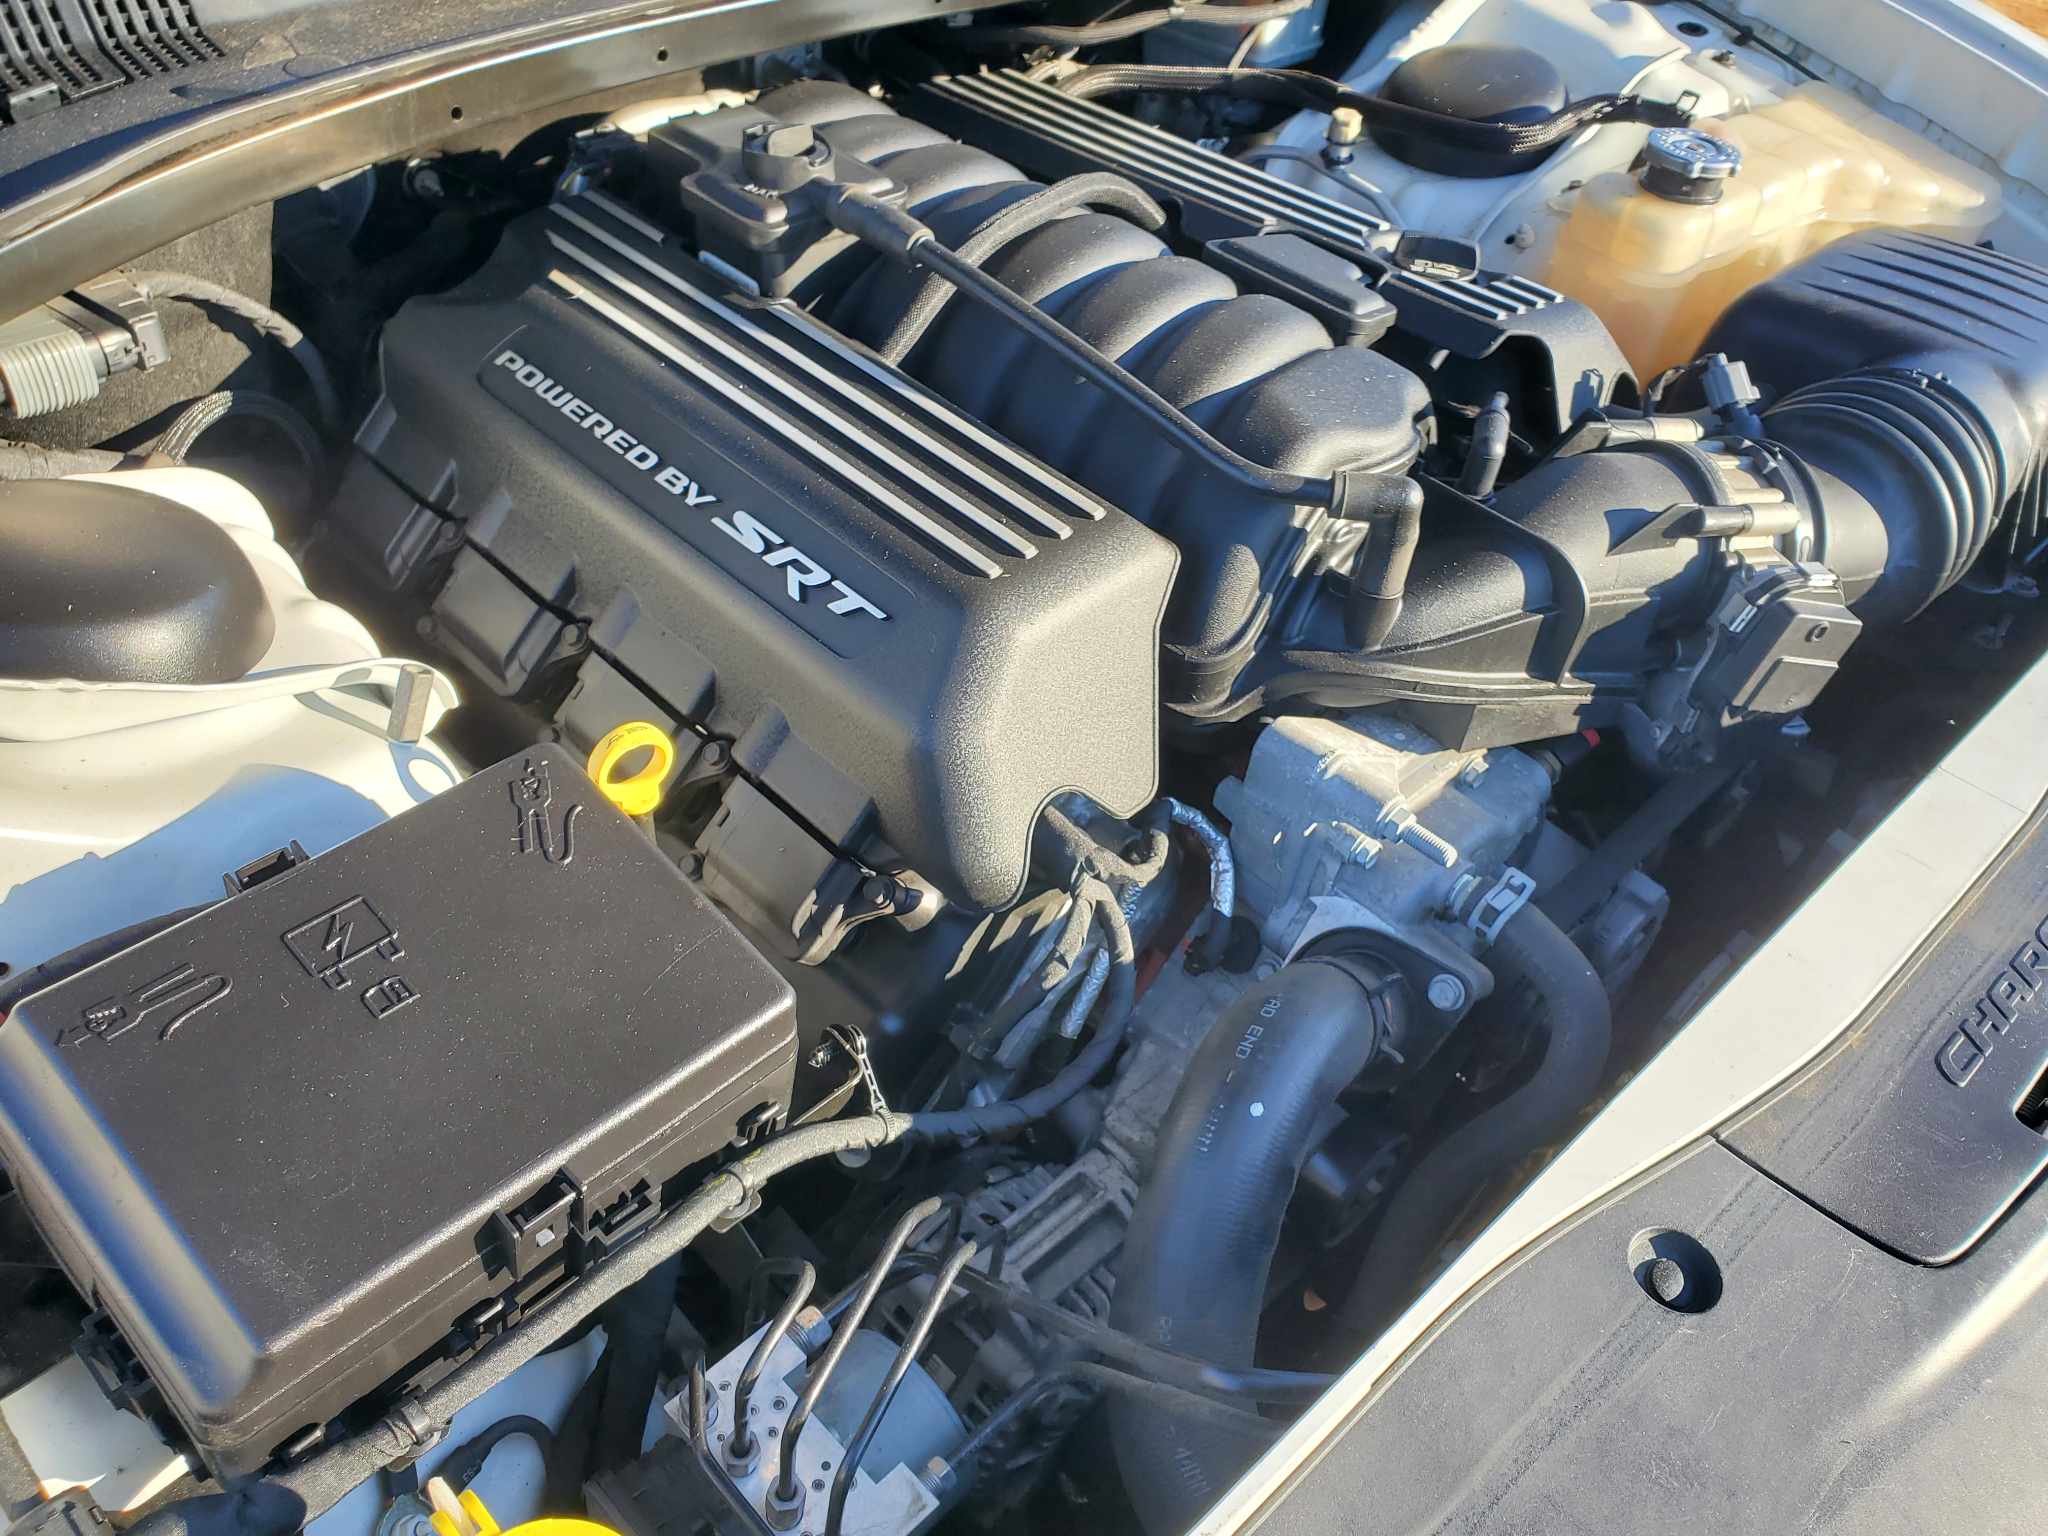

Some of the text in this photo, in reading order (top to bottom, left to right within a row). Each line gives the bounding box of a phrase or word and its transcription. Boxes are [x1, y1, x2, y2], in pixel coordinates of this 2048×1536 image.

[493, 349, 888, 620] POWERED BY SRT
[1235, 993, 1283, 1060] AD END
